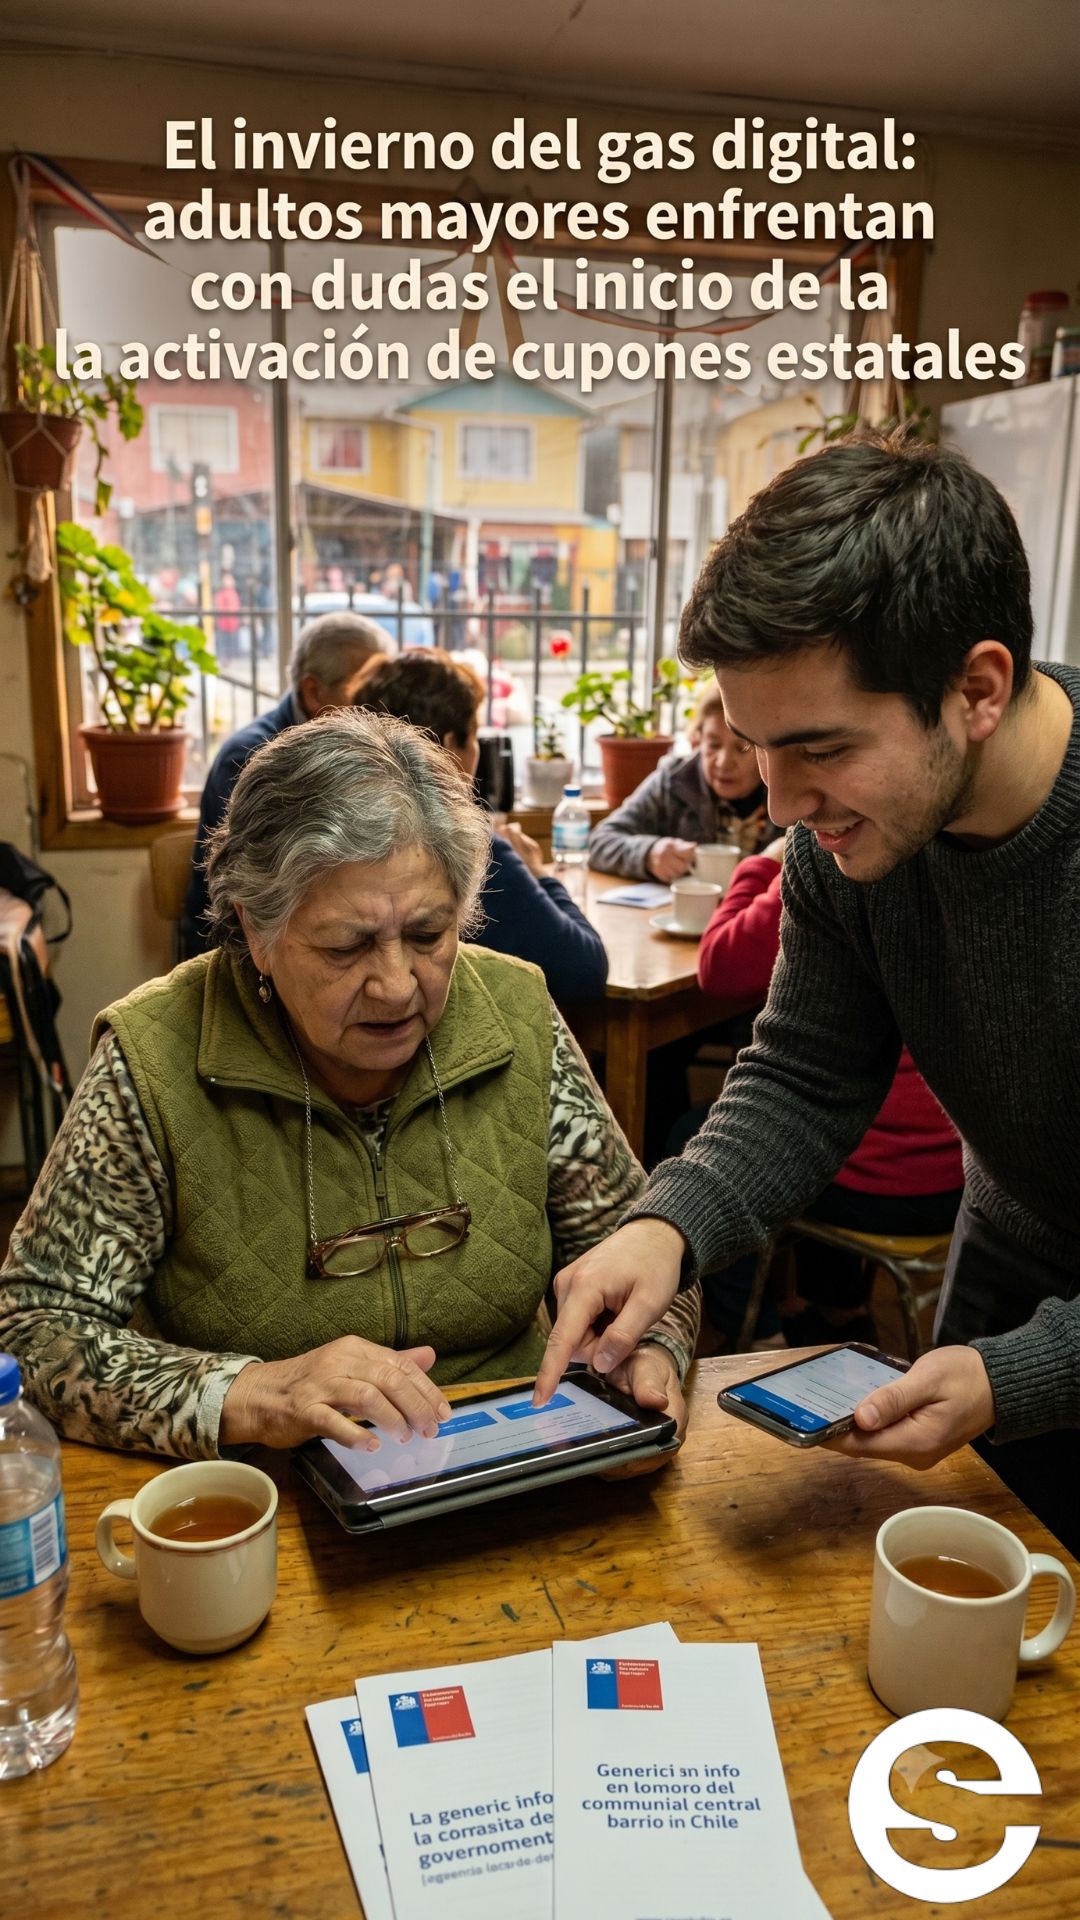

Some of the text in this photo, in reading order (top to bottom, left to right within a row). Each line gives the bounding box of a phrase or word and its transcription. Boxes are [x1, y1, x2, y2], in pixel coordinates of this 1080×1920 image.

[596, 1763, 675, 1778] Generici
[704, 1764, 741, 1778] info
[606, 1781, 735, 1794] en lomoro del
[409, 1791, 554, 1826] La generic info
[581, 1797, 761, 1811] communial central
[607, 1814, 739, 1829] barrio in Chile
[413, 1831, 432, 1846] la
[438, 1818, 525, 1842] corrasita
[418, 1830, 554, 1870] governoment
